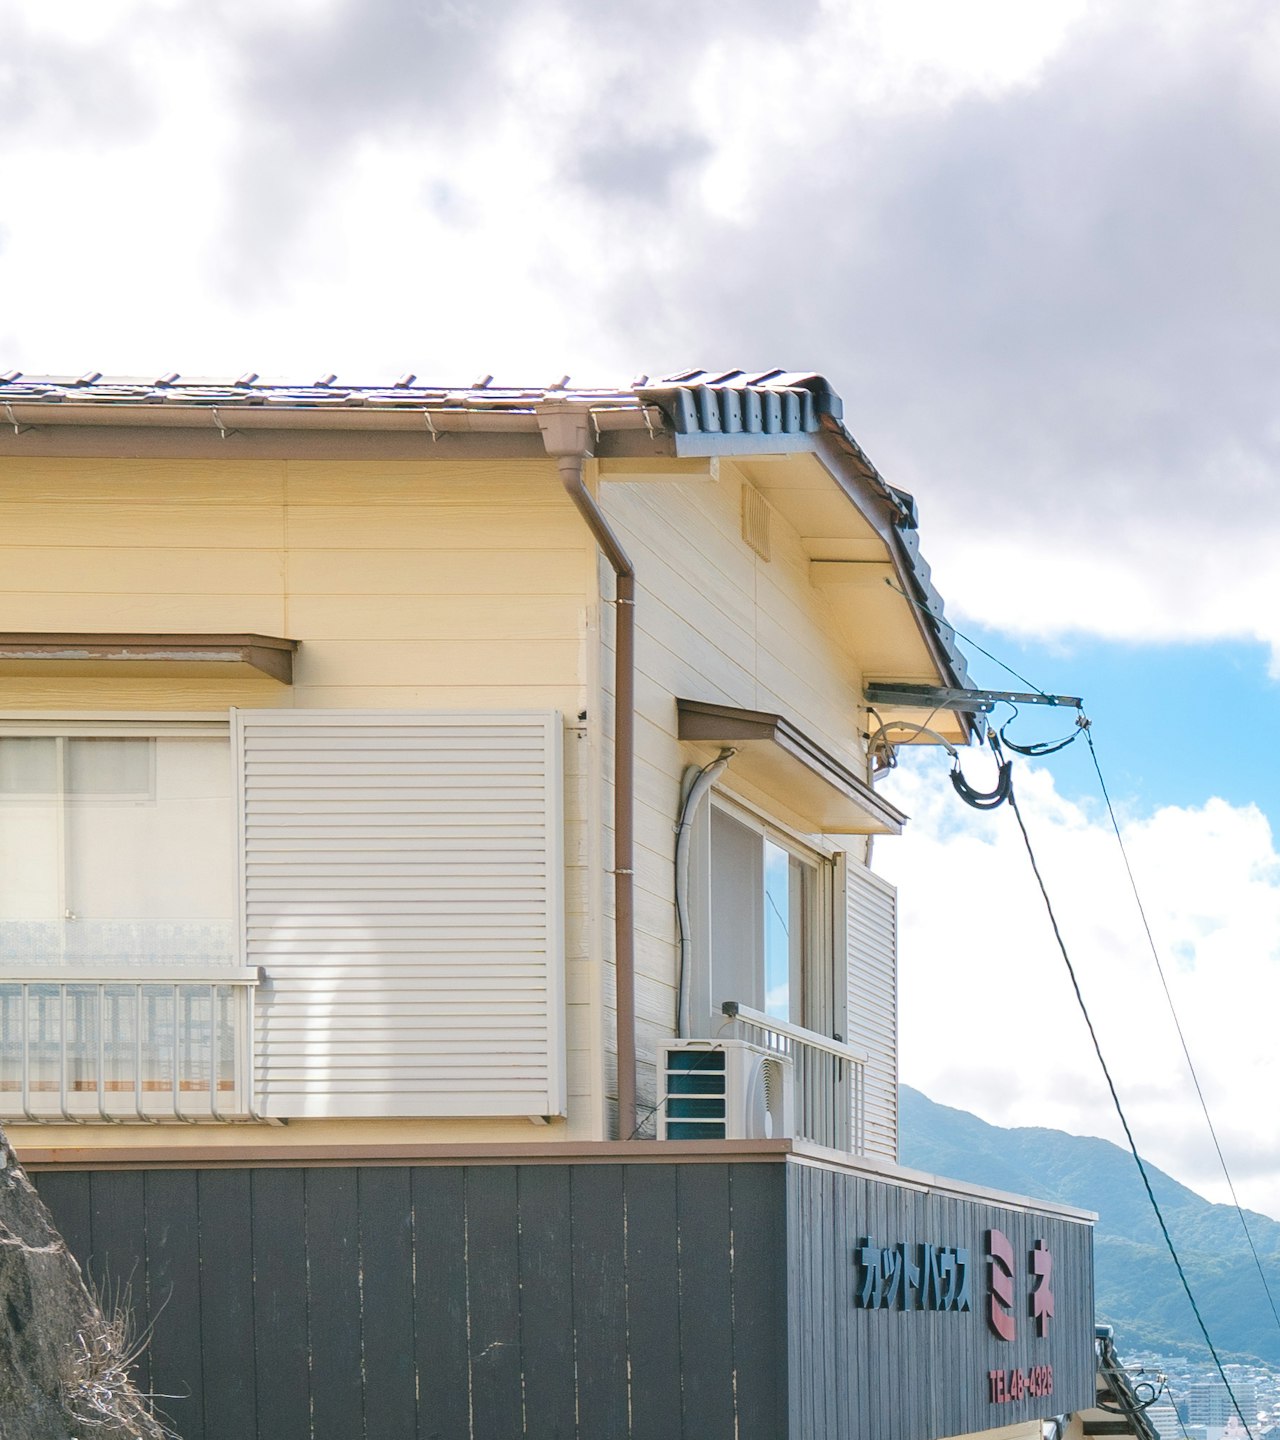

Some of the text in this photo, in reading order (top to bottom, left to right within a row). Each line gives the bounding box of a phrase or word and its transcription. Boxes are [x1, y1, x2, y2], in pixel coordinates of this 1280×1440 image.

[858, 1229, 1054, 1341] カットハウス ミネ
